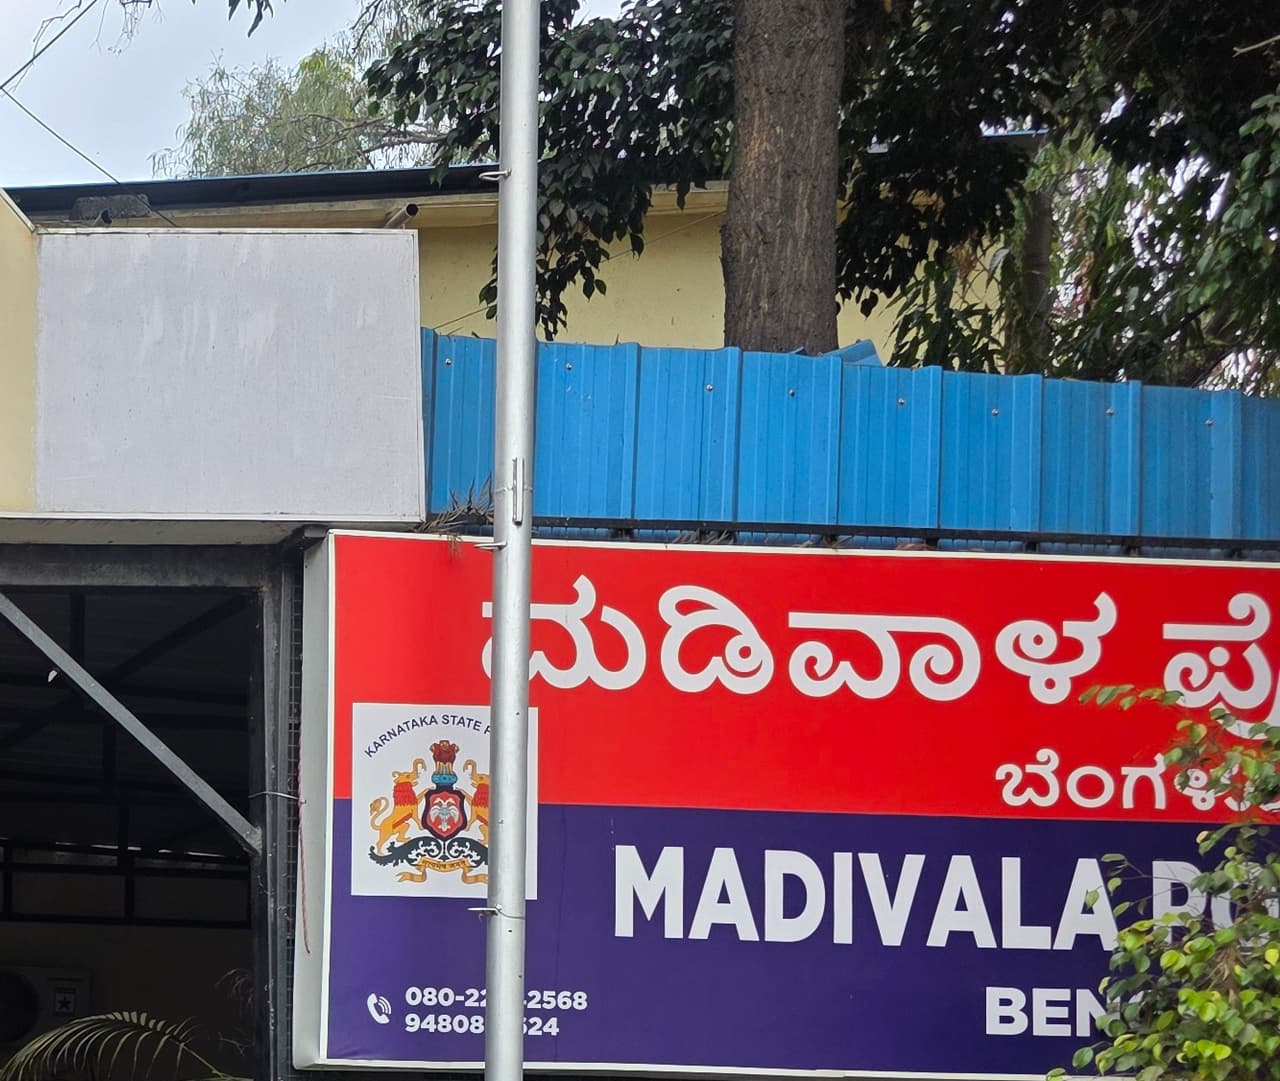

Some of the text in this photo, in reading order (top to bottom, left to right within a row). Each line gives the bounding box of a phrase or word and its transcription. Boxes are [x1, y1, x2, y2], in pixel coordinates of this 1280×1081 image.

[482, 574, 1117, 704] ಮಡಿವಾಳ
[364, 714, 482, 758] KARNATAKA STATE
[613, 844, 1118, 952] MADIVALA
